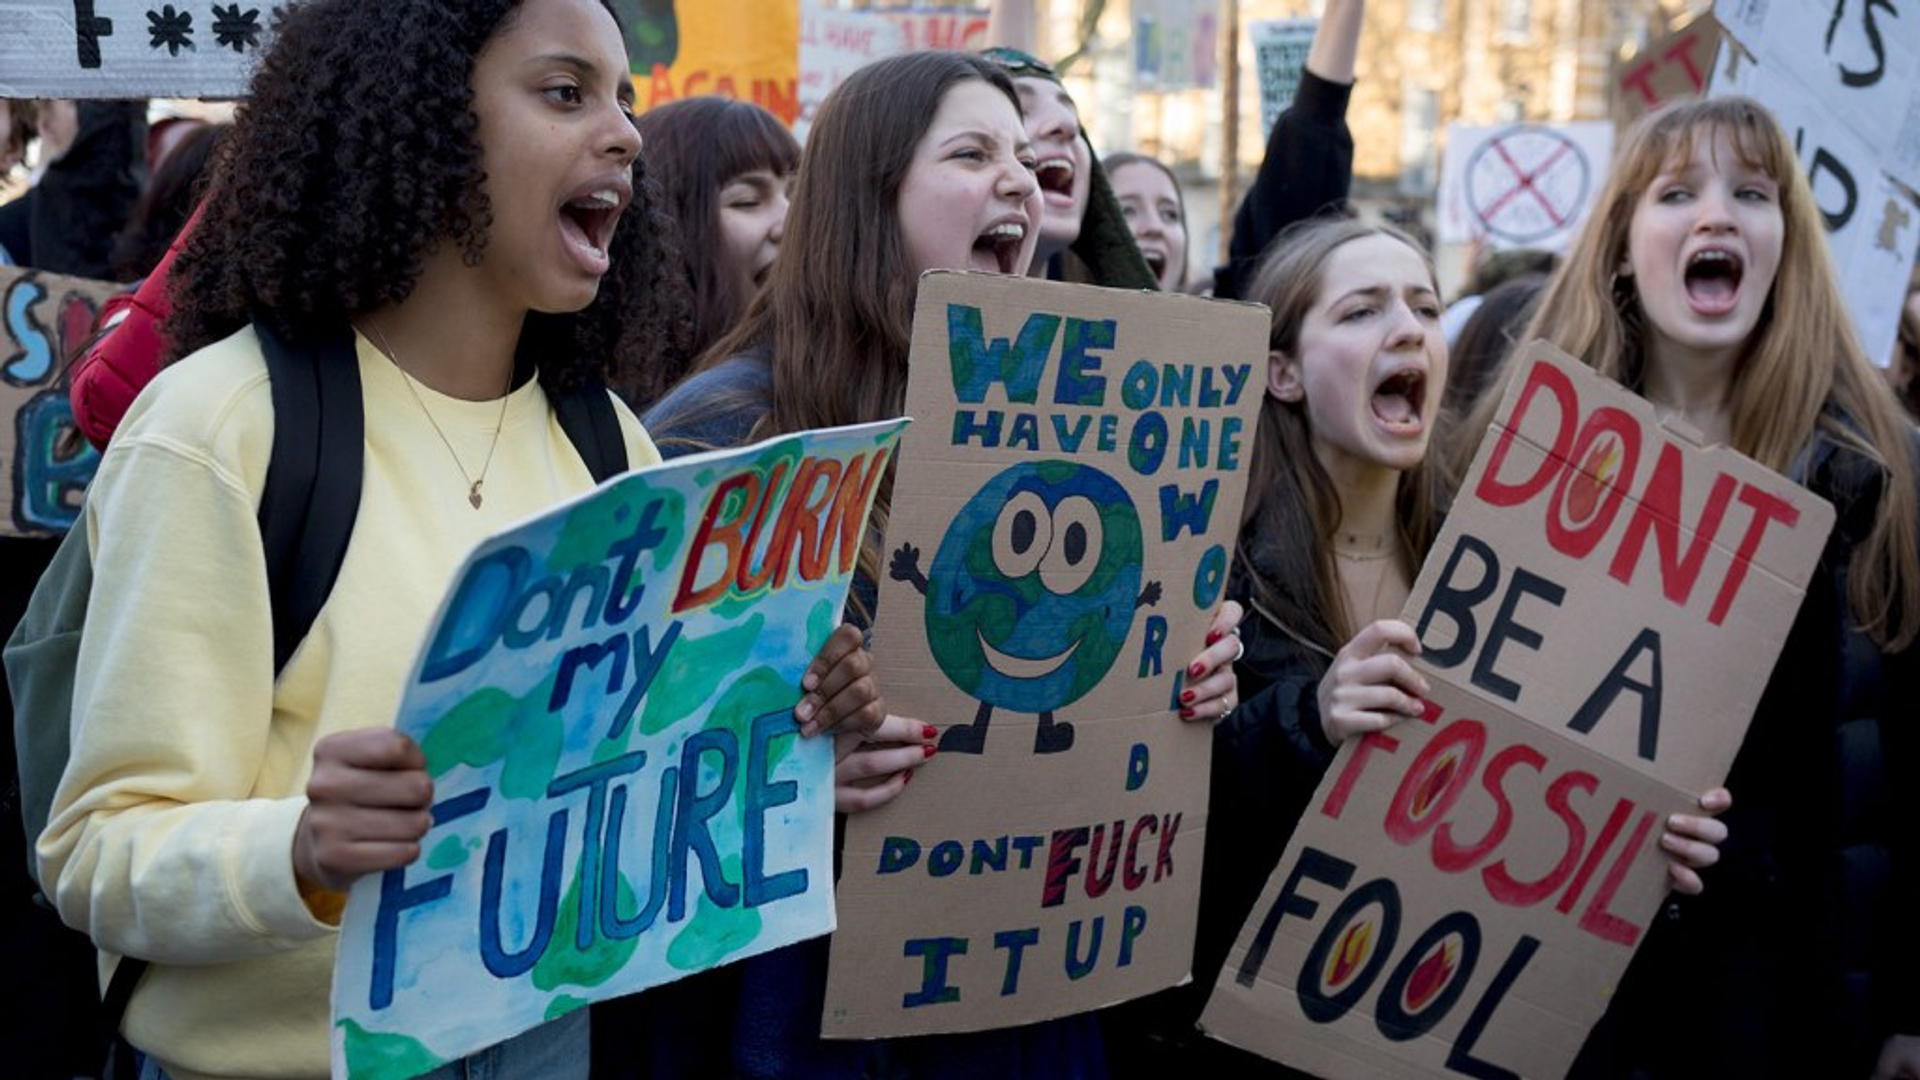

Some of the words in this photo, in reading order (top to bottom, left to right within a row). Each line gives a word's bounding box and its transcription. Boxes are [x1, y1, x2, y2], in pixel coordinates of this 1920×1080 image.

[947, 303, 1117, 406] WE
[1121, 360, 1252, 411] ONLY
[951, 410, 1118, 453] HAVE
[1128, 410, 1243, 476] ONE
[1475, 360, 1800, 627] DONT
[671, 448, 888, 614] BURN
[548, 620, 684, 739] my
[1415, 534, 1567, 703] BE
[1566, 627, 1663, 762] A
[369, 706, 809, 1011] FUTURE
[876, 835, 1044, 877] DONT
[1041, 812, 1183, 908] FUCK
[1320, 698, 1658, 948] FOSSIL
[1065, 905, 1148, 981] UP
[1235, 846, 1542, 1080] FOOL
